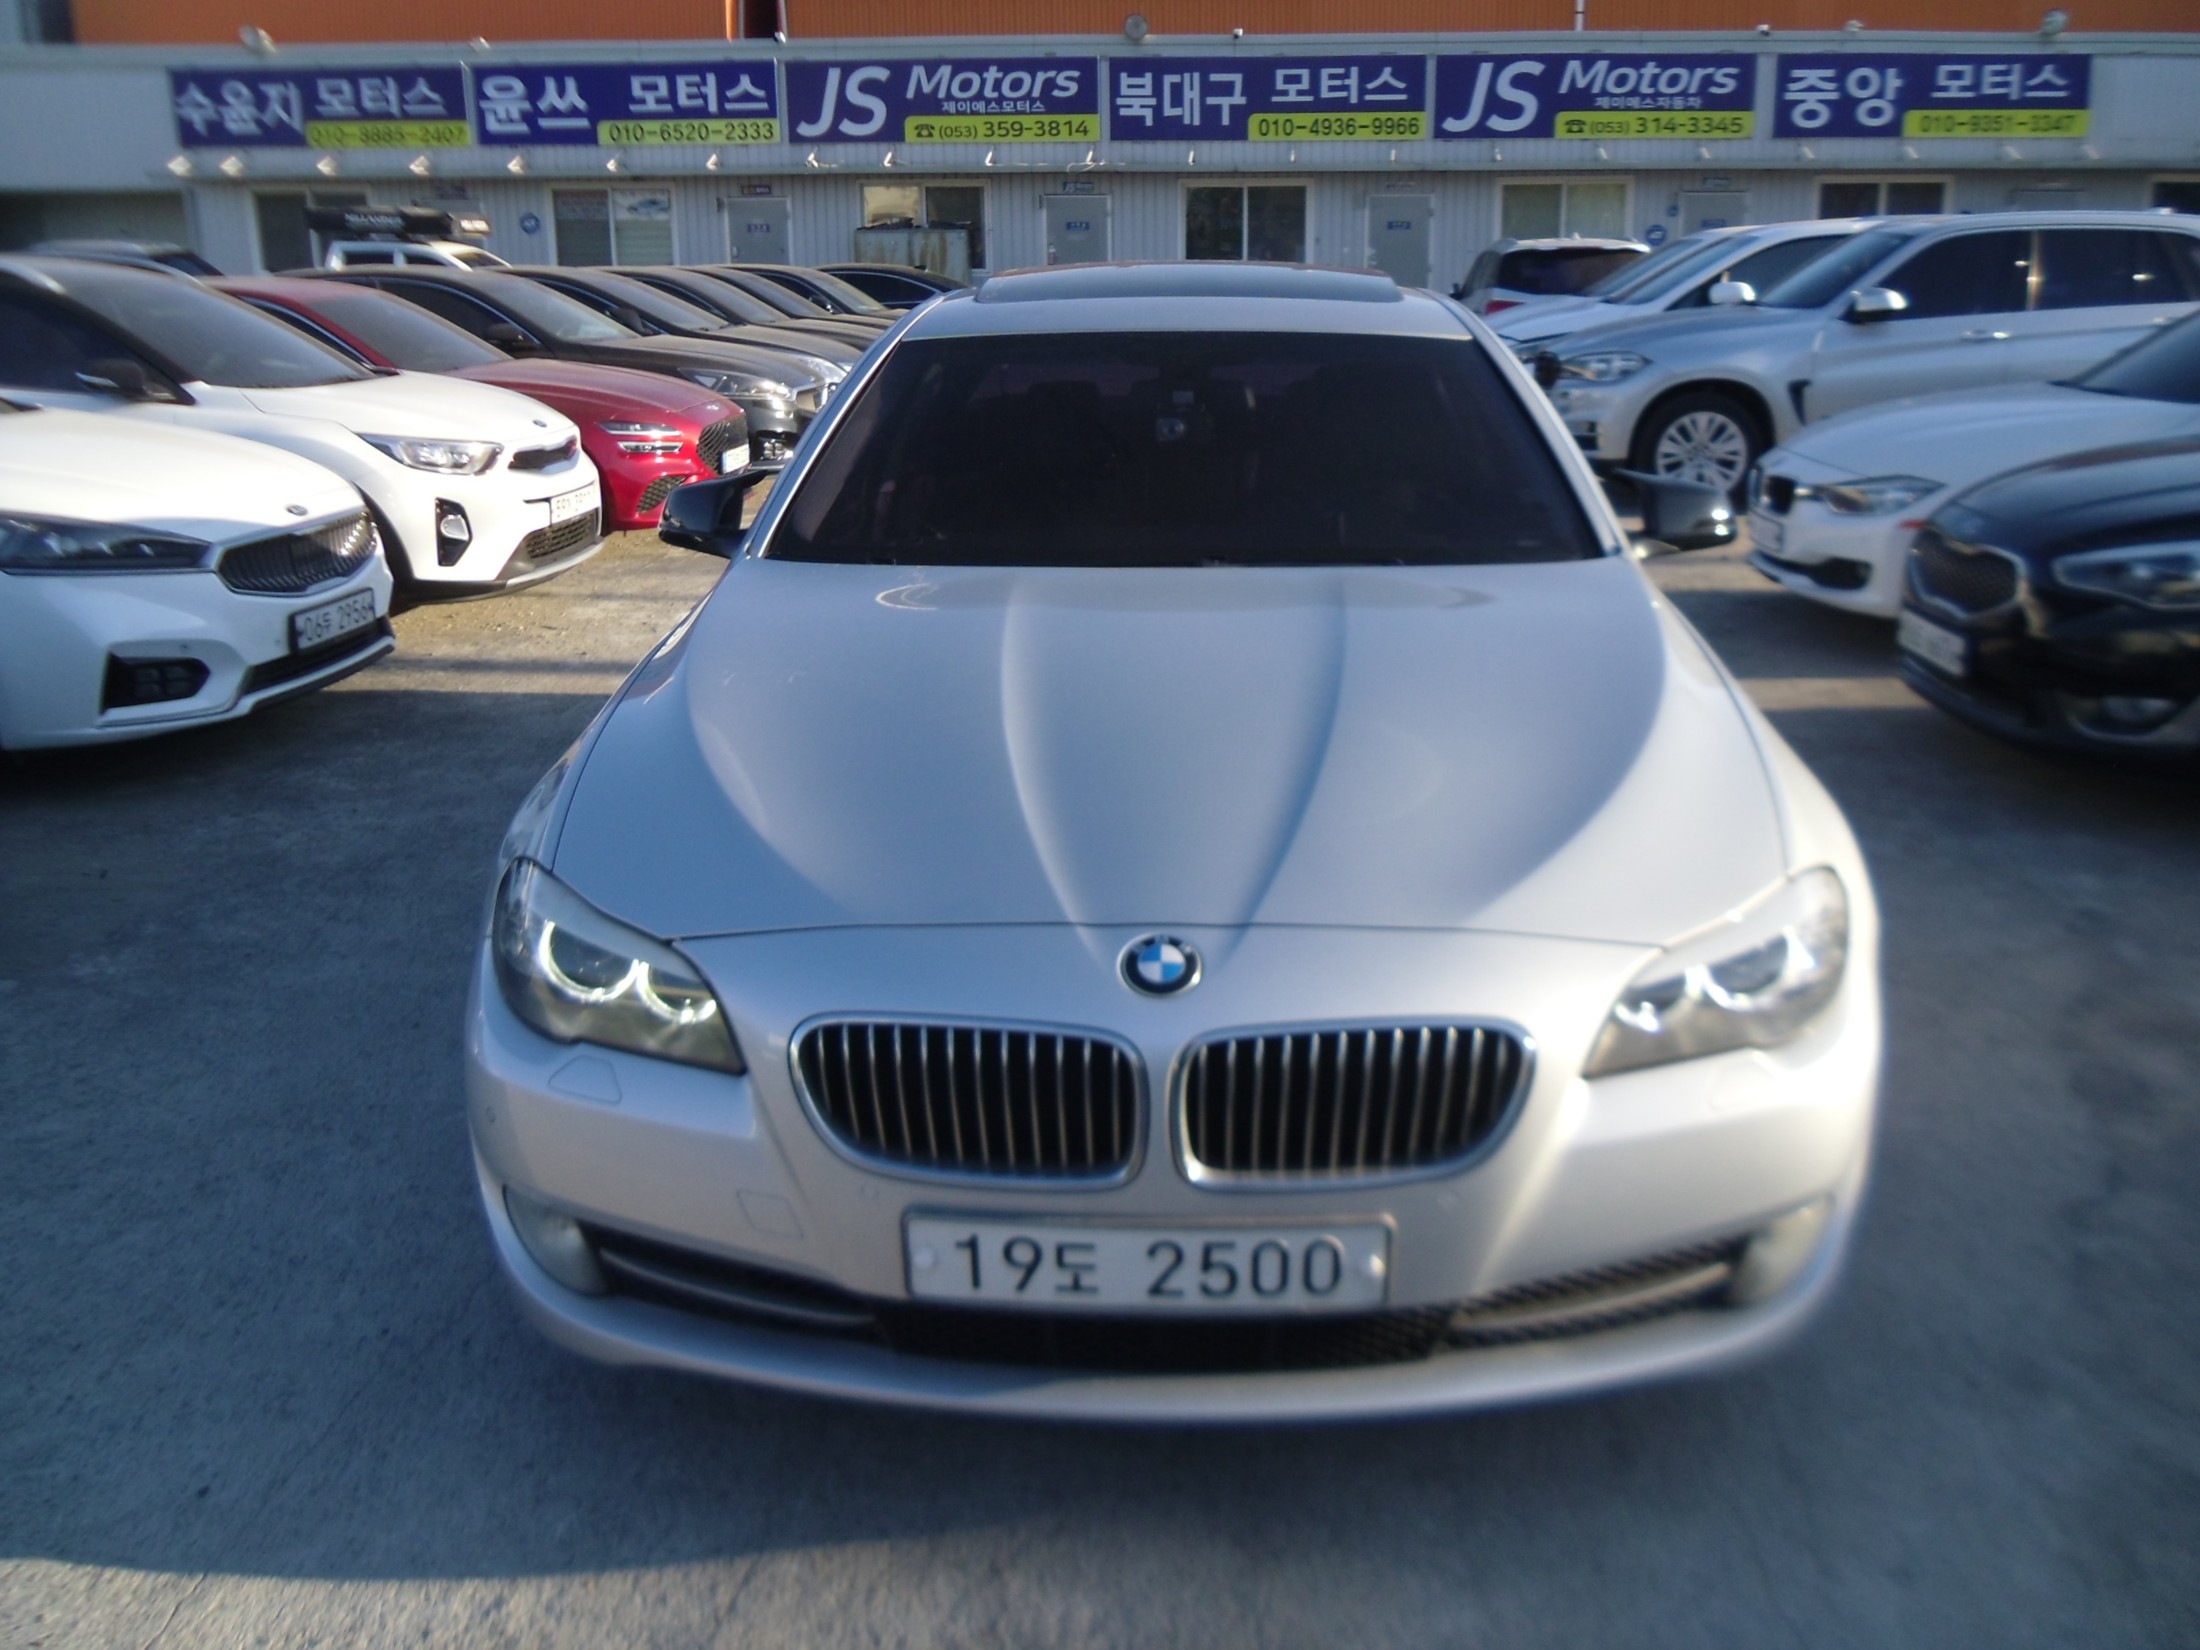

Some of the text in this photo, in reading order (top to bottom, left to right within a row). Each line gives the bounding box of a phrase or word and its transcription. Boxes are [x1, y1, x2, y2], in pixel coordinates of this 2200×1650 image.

[315, 76, 448, 117] 모터스
[628, 73, 769, 114] 모터스
[796, 64, 1081, 137] JS Motors
[942, 100, 1046, 114] 제이에스모터스
[1116, 66, 1408, 126] 북대구 모터스
[1441, 59, 1740, 133] JS Motors
[1784, 63, 2070, 129] 중앙 모터스
[608, 121, 775, 142] 010-6520-2333
[939, 119, 1089, 139] (053) 359-3814
[1258, 117, 1420, 137] 010-4936-9966
[1590, 116, 1743, 134] (053) 314-3345
[955, 1233, 1346, 1297] 19도 2500
